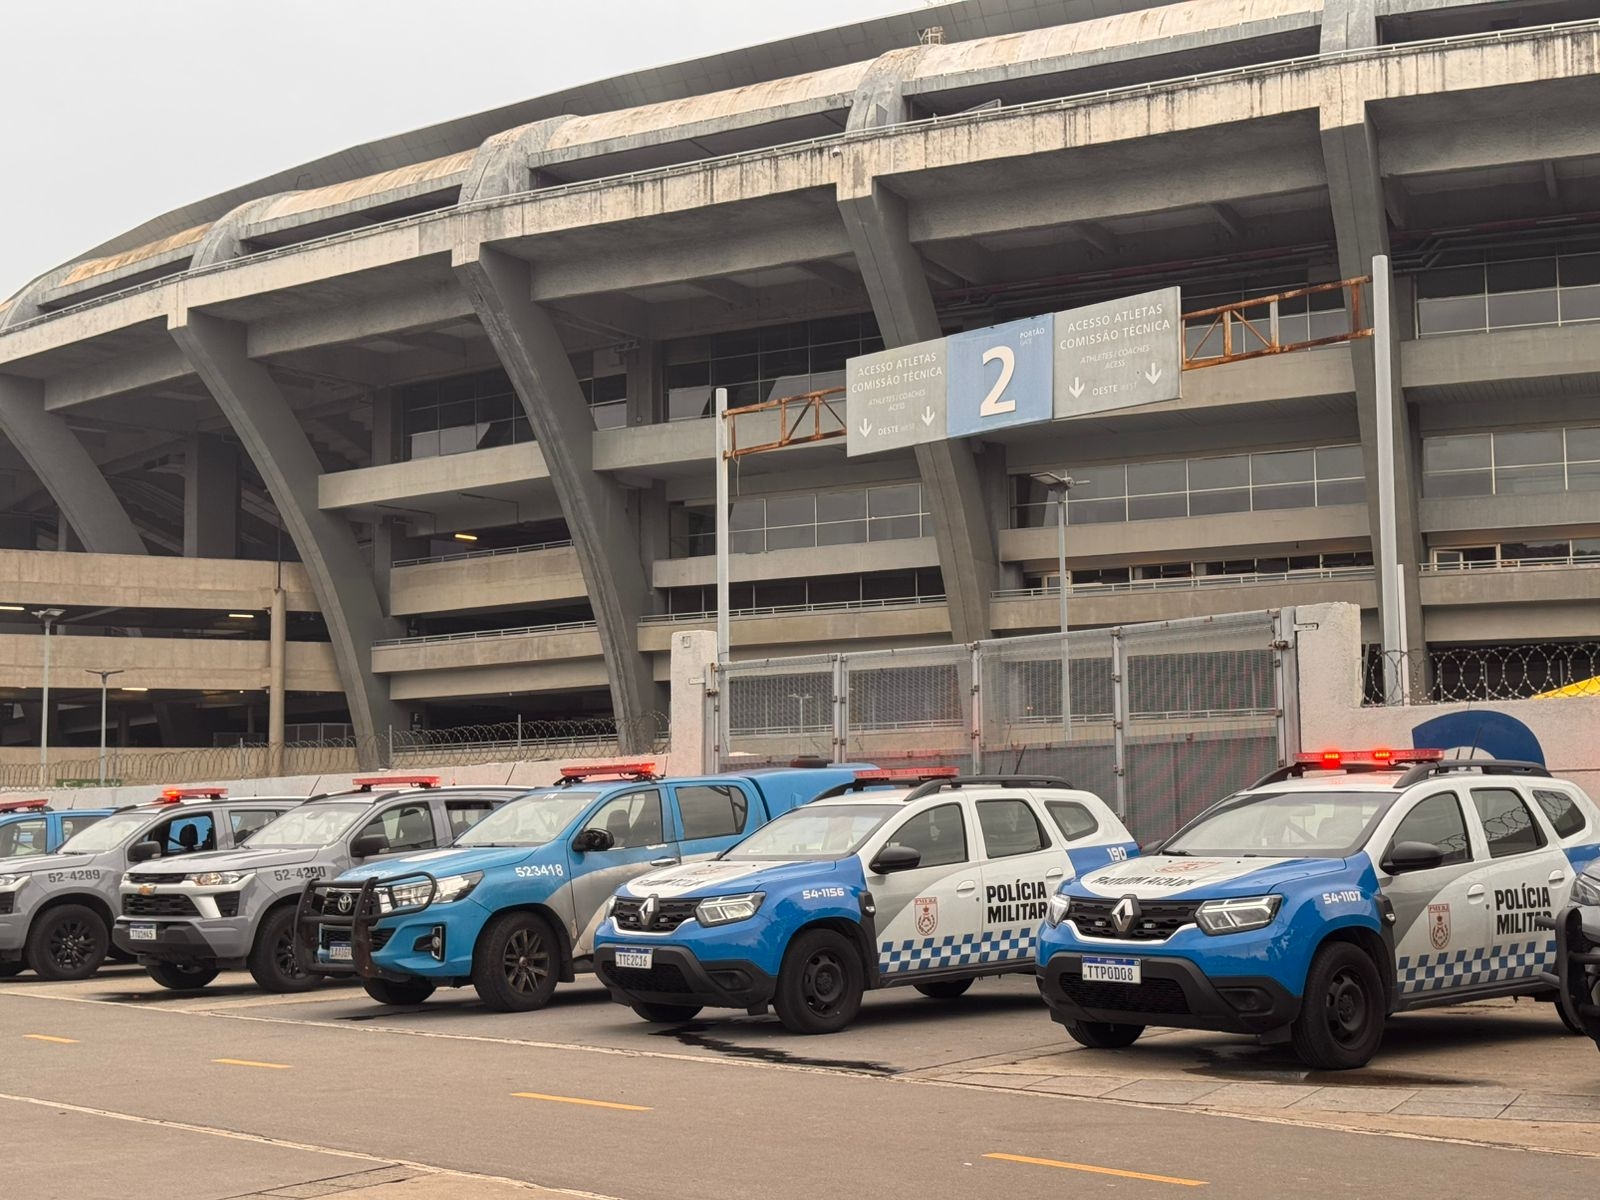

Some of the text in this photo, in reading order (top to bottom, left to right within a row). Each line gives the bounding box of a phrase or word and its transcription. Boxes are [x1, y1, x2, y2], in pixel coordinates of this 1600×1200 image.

[1068, 304, 1162, 333] ACESSO ATLETAS
[1060, 320, 1170, 350] COMISSÃO TÉCNICA
[858, 352, 937, 377] ACESSO ATLETAS
[852, 367, 943, 393] COMISSÃO TÉCNICA
[980, 345, 1016, 417] 2
[1092, 384, 1118, 396] OESTE
[1106, 846, 1128, 861] 190
[48, 869, 100, 883] 52-4289
[515, 864, 564, 878] 523418
[986, 879, 1047, 903] POLÍCIA
[1494, 882, 1551, 911] POLÍCIA
[987, 902, 1048, 924] MILITAR
